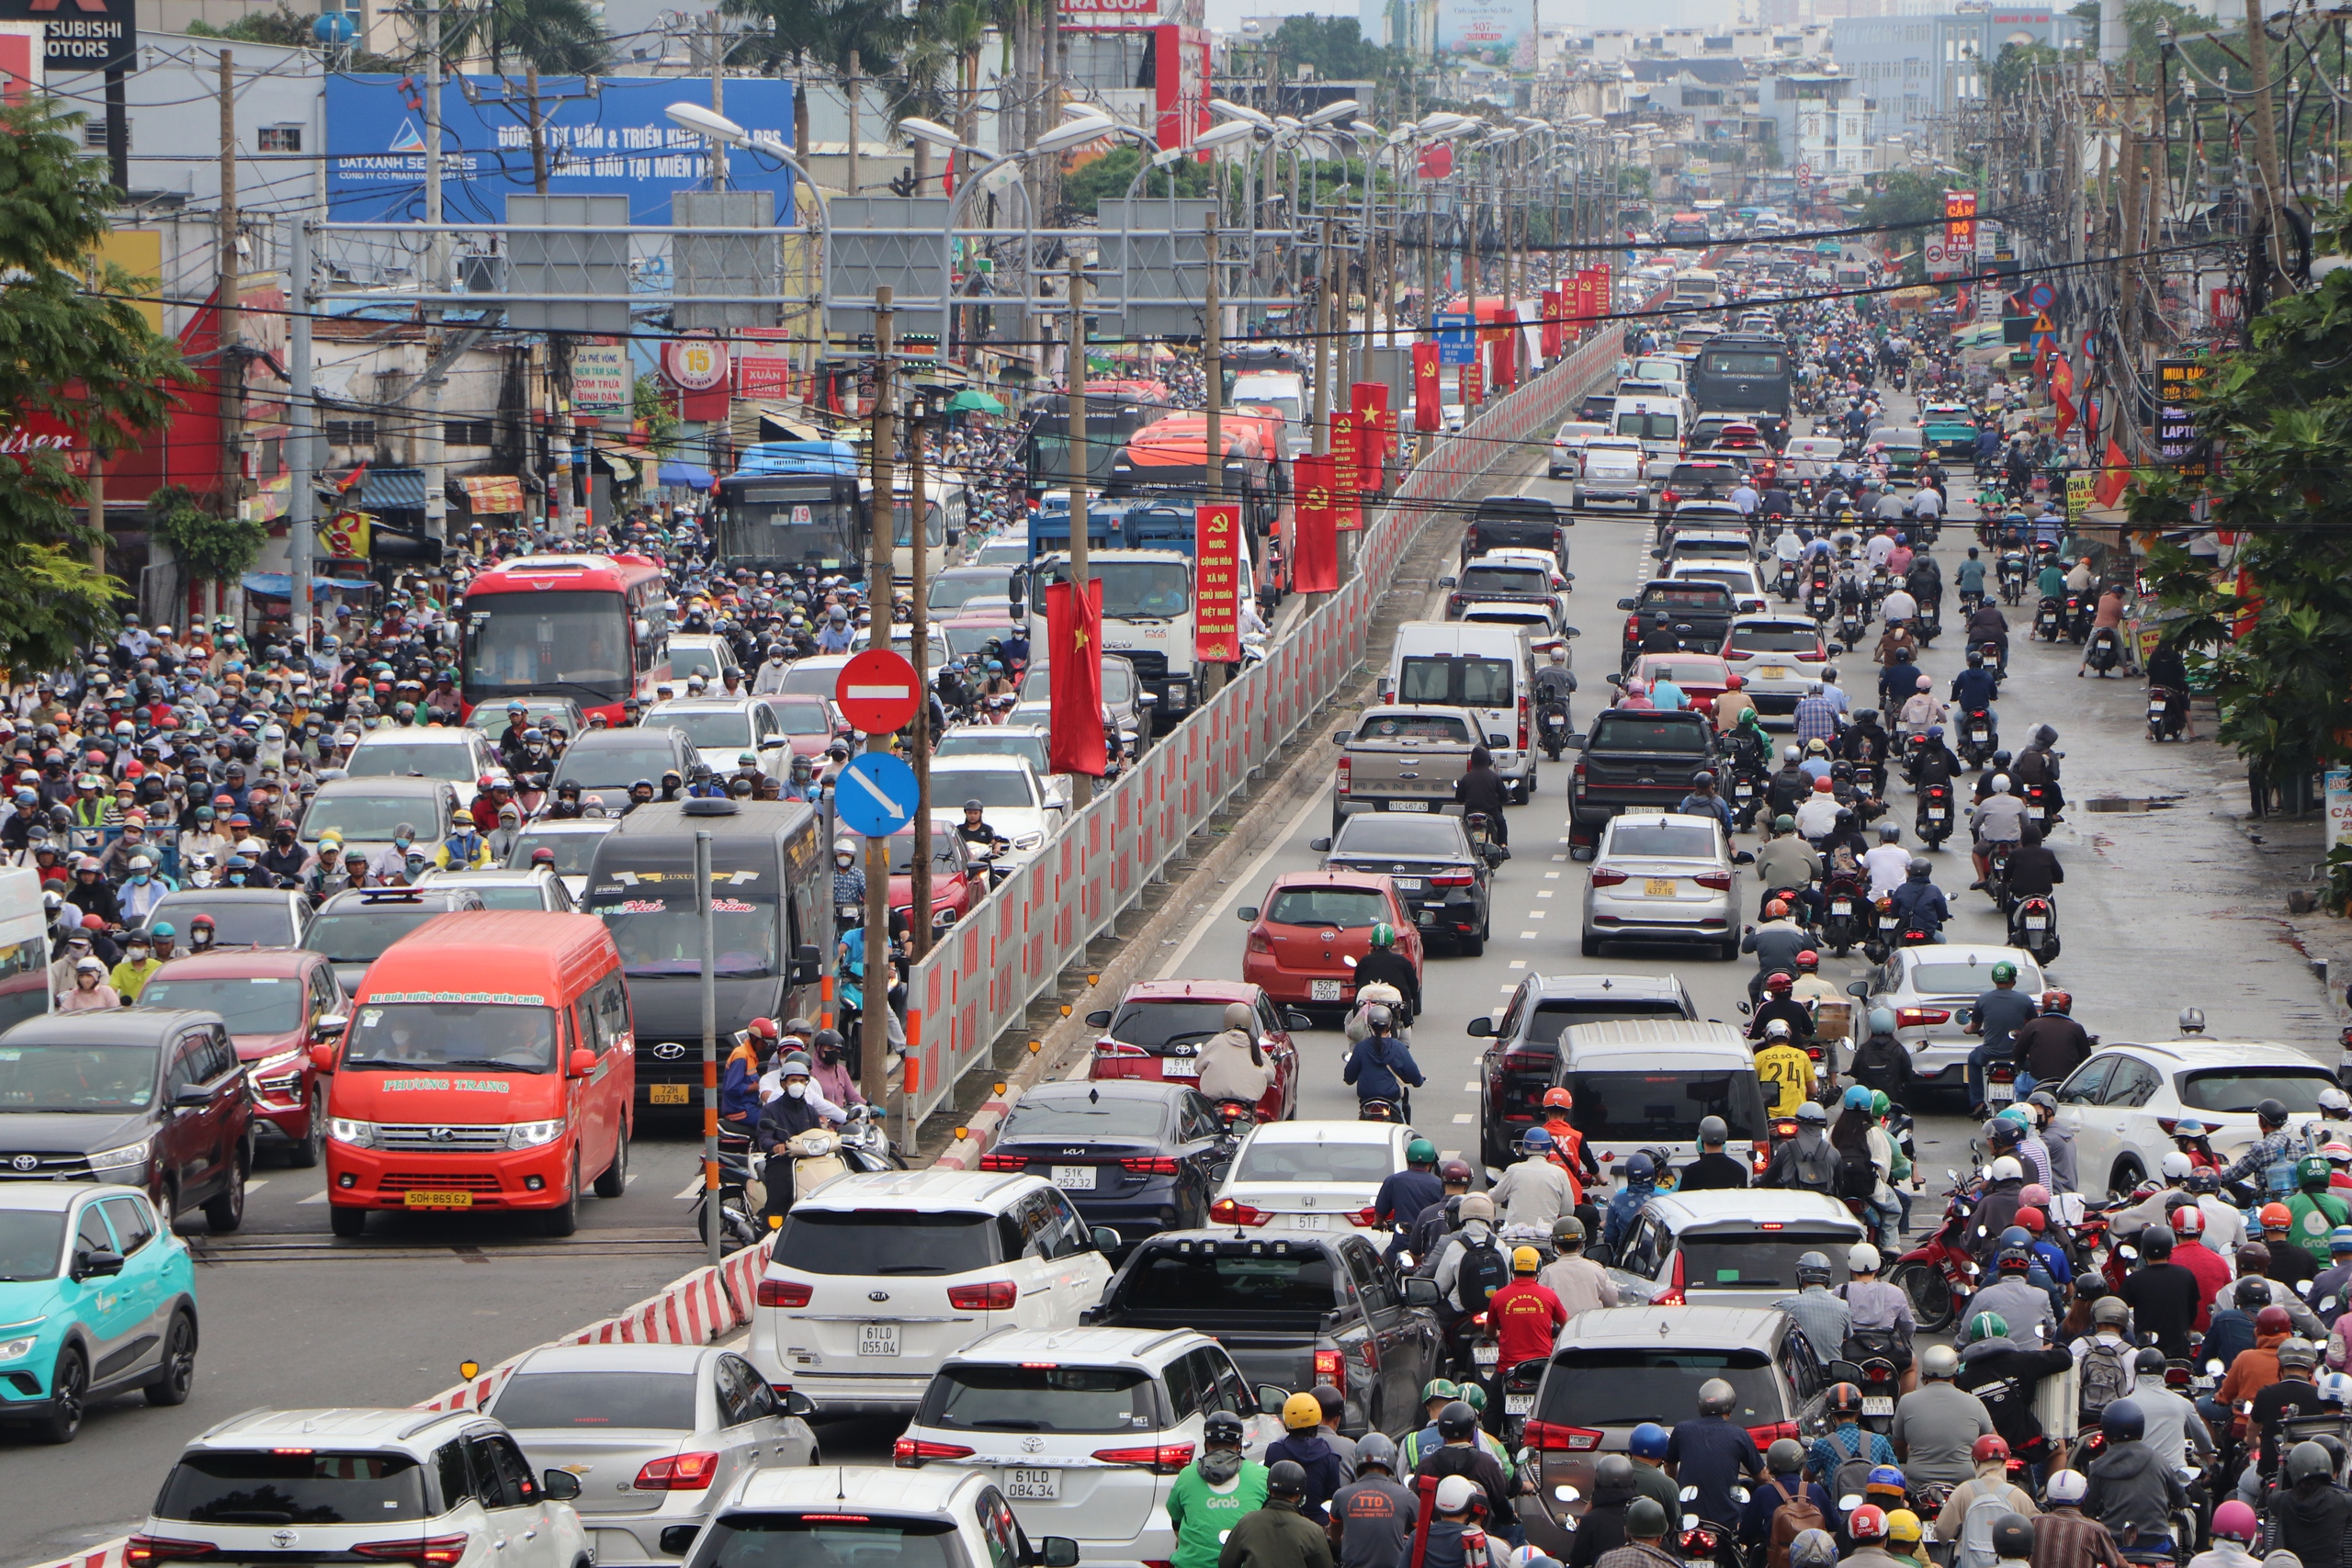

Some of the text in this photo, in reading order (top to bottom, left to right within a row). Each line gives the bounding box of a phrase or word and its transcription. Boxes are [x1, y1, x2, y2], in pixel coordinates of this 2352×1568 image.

[1473, 23, 1491, 32] 507
[43, 40, 109, 58] OTORS
[686, 349, 710, 372] 15
[749, 368, 781, 380] XUÂN
[2163, 368, 2185, 380] MUA
[748, 381, 781, 392] HÙNG
[2069, 491, 2095, 499] 14.00
[794, 508, 808, 523] 19
[1208, 539, 1227, 549] NƯỚC
[1201, 556, 1233, 567] CỘNG HÒA
[1206, 572, 1228, 584] XÃ HỘI
[1199, 588, 1233, 600] CHỦ NGHĨA
[1202, 607, 1231, 619] VIỆT NAM
[1199, 623, 1235, 634] MUÔN NĂM
[1390, 802, 1428, 811] 61C-467.45
[1647, 887, 1673, 896] 437.16
[1317, 981, 1334, 990] 52F
[369, 991, 545, 1005] XE RƯỚC CÔNG CHỨC VIÊN CHỨC
[1314, 990, 1338, 999] 7507
[1174, 1058, 1191, 1066] 61K
[1167, 1067, 1197, 1076] 221.1
[1768, 1061, 1801, 1091] 24
[383, 1077, 510, 1094] PHƯƠNG TRANG
[661, 1086, 678, 1094] 72H
[654, 1094, 684, 1103] 037.94
[1064, 1168, 1083, 1178] 51K
[2307, 1168, 2326, 1177] Grab
[1057, 1178, 1091, 1188] 252.32
[410, 1193, 467, 1204] 50H-869.62
[1299, 1216, 1320, 1228] 51F
[2301, 1236, 2330, 1249] Grab
[866, 1326, 892, 1339] 61LD
[862, 1340, 896, 1354] 055.04
[1507, 1404, 1529, 1413] 235.5
[1864, 1405, 1892, 1415] 077.99
[978, 1456, 1089, 1465] FORTUNER
[1015, 1471, 1049, 1484] 61LD
[1009, 1483, 1056, 1497] 084.34
[1206, 1495, 1240, 1508] Grab
[1358, 1496, 1384, 1507] TTD
